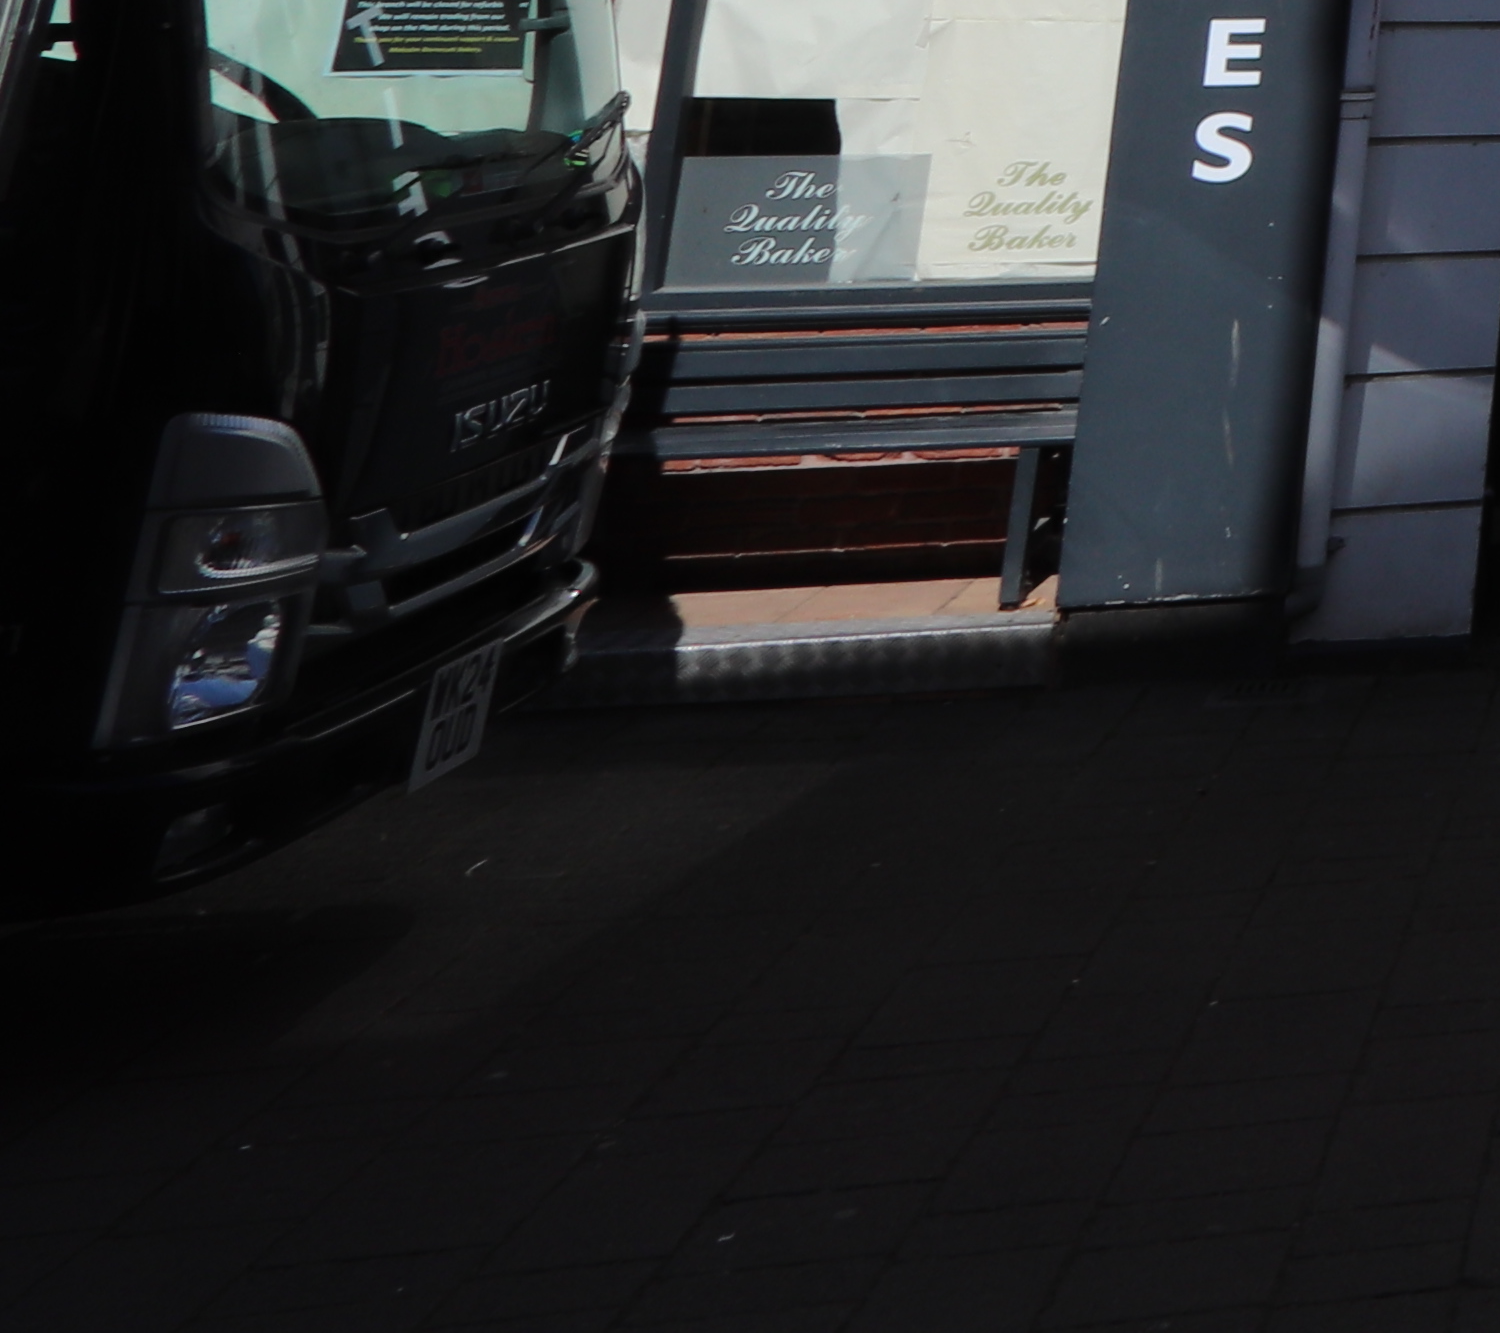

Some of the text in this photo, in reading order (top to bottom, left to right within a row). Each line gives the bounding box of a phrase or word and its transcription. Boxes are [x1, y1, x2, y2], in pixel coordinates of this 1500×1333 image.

[765, 170, 842, 202] The
[996, 160, 1067, 188] The
[723, 204, 871, 241] Quality
[963, 191, 1094, 225] Quality
[730, 236, 856, 267] Baker
[967, 224, 1079, 253] Baker
[449, 379, 551, 454] ISUZU
